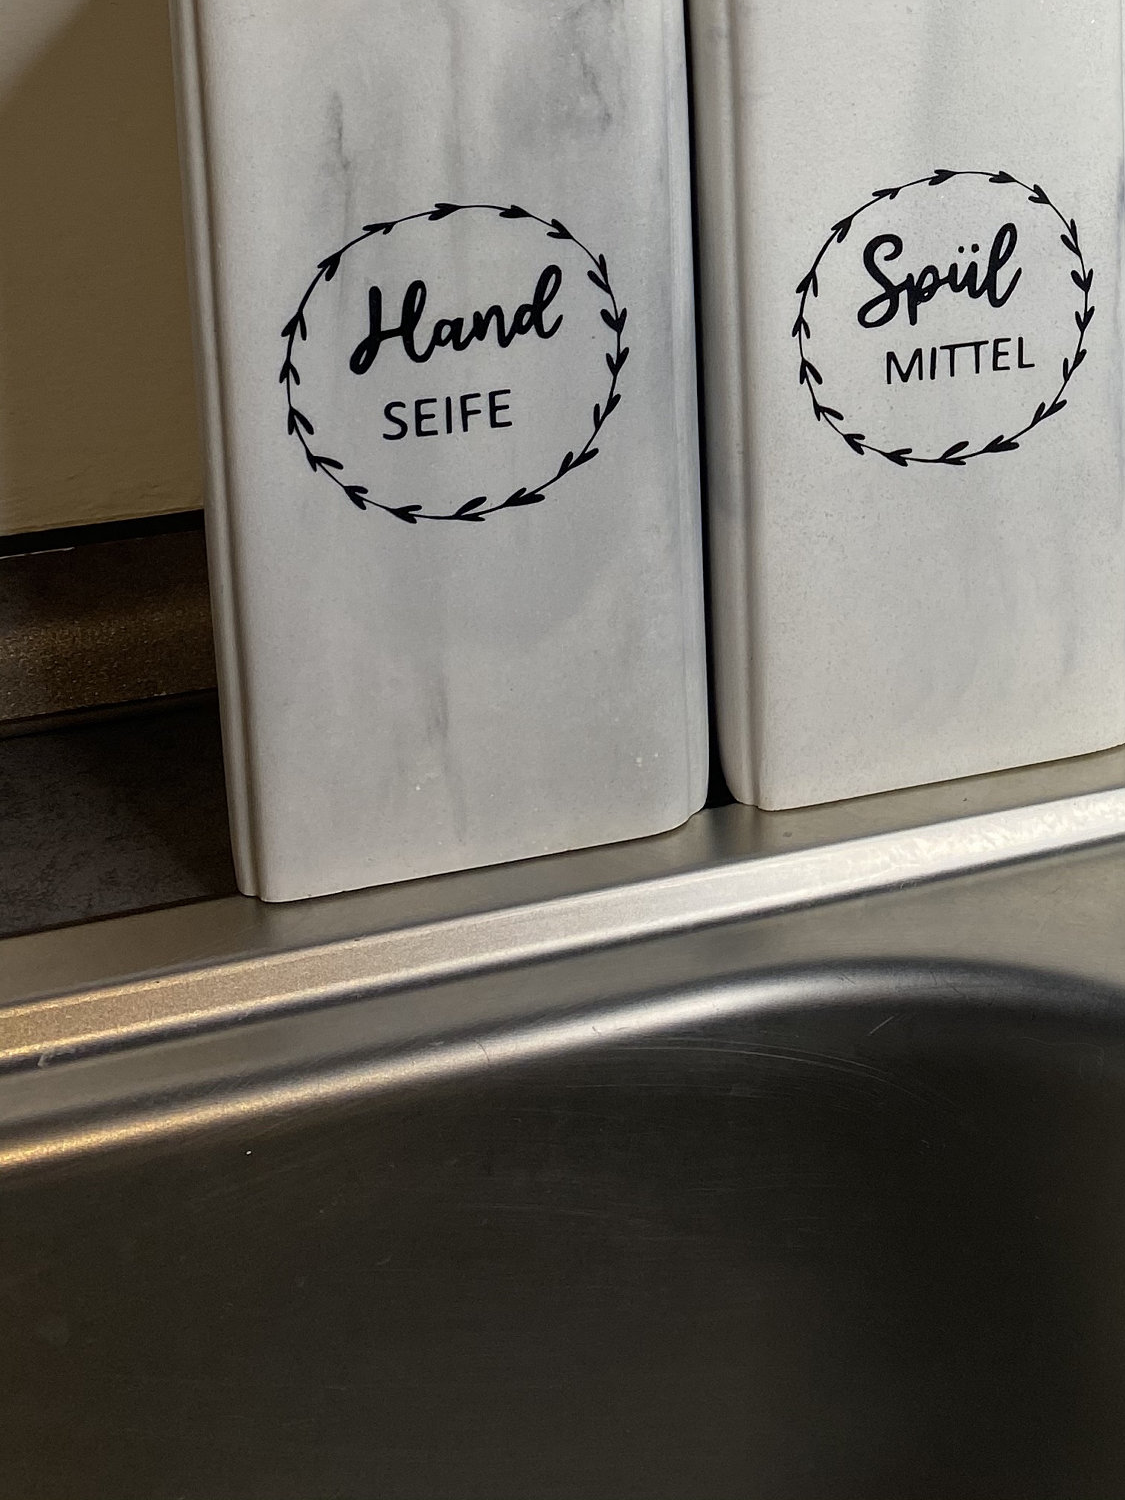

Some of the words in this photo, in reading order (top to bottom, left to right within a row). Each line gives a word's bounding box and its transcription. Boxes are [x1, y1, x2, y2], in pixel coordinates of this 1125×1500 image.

[857, 222, 1023, 329] Spül
[348, 264, 564, 376] Hand
[886, 336, 1036, 385] MITTEL
[382, 388, 514, 441] SEIFE
